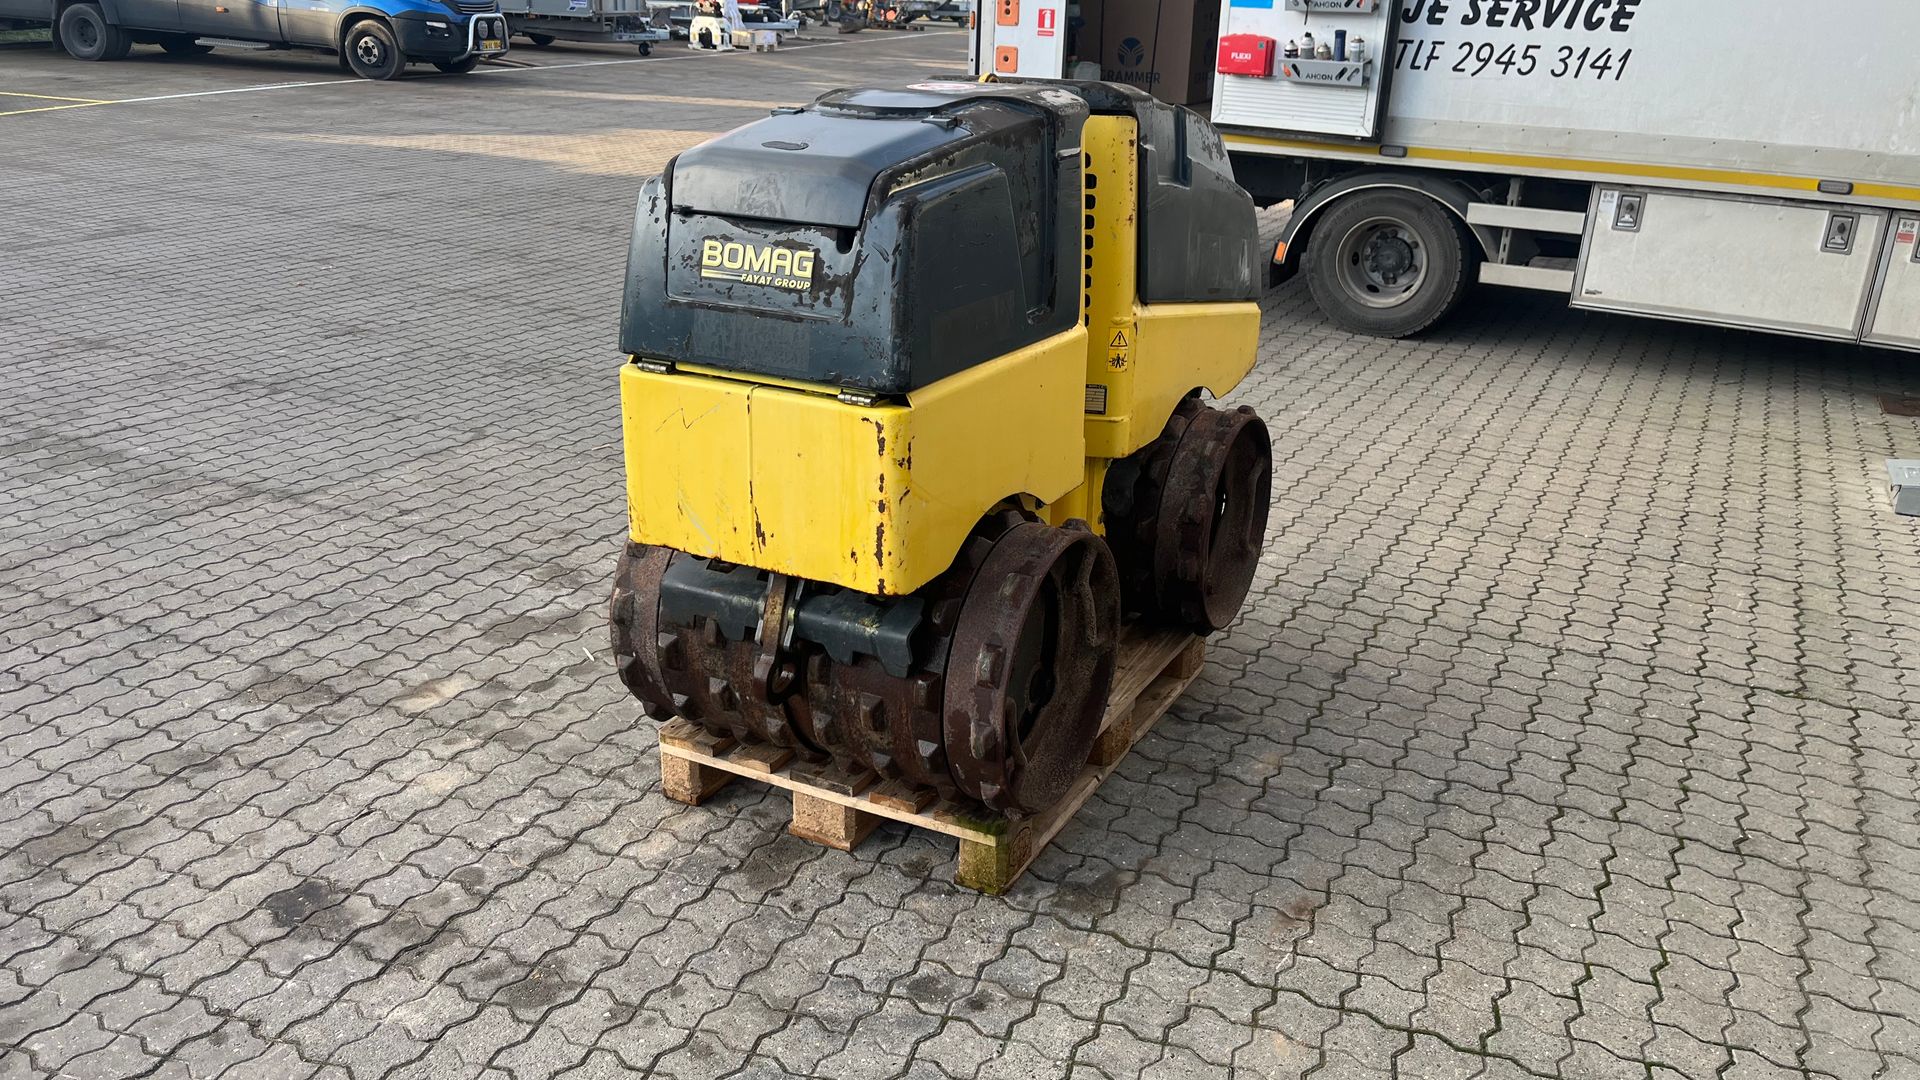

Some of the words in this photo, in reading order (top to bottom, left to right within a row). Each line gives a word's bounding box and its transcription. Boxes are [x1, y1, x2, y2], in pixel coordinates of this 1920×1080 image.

[1401, 0, 1449, 25] JE
[1461, 0, 1641, 32] SERVICE
[1231, 51, 1252, 60] FLEXI
[1395, 39, 1446, 71] TLF
[1452, 41, 1541, 77] 2945
[1551, 45, 1633, 81] 3141
[702, 239, 815, 279] BOMAG
[740, 273, 773, 285] FAYAT
[774, 277, 812, 290] GROUP
